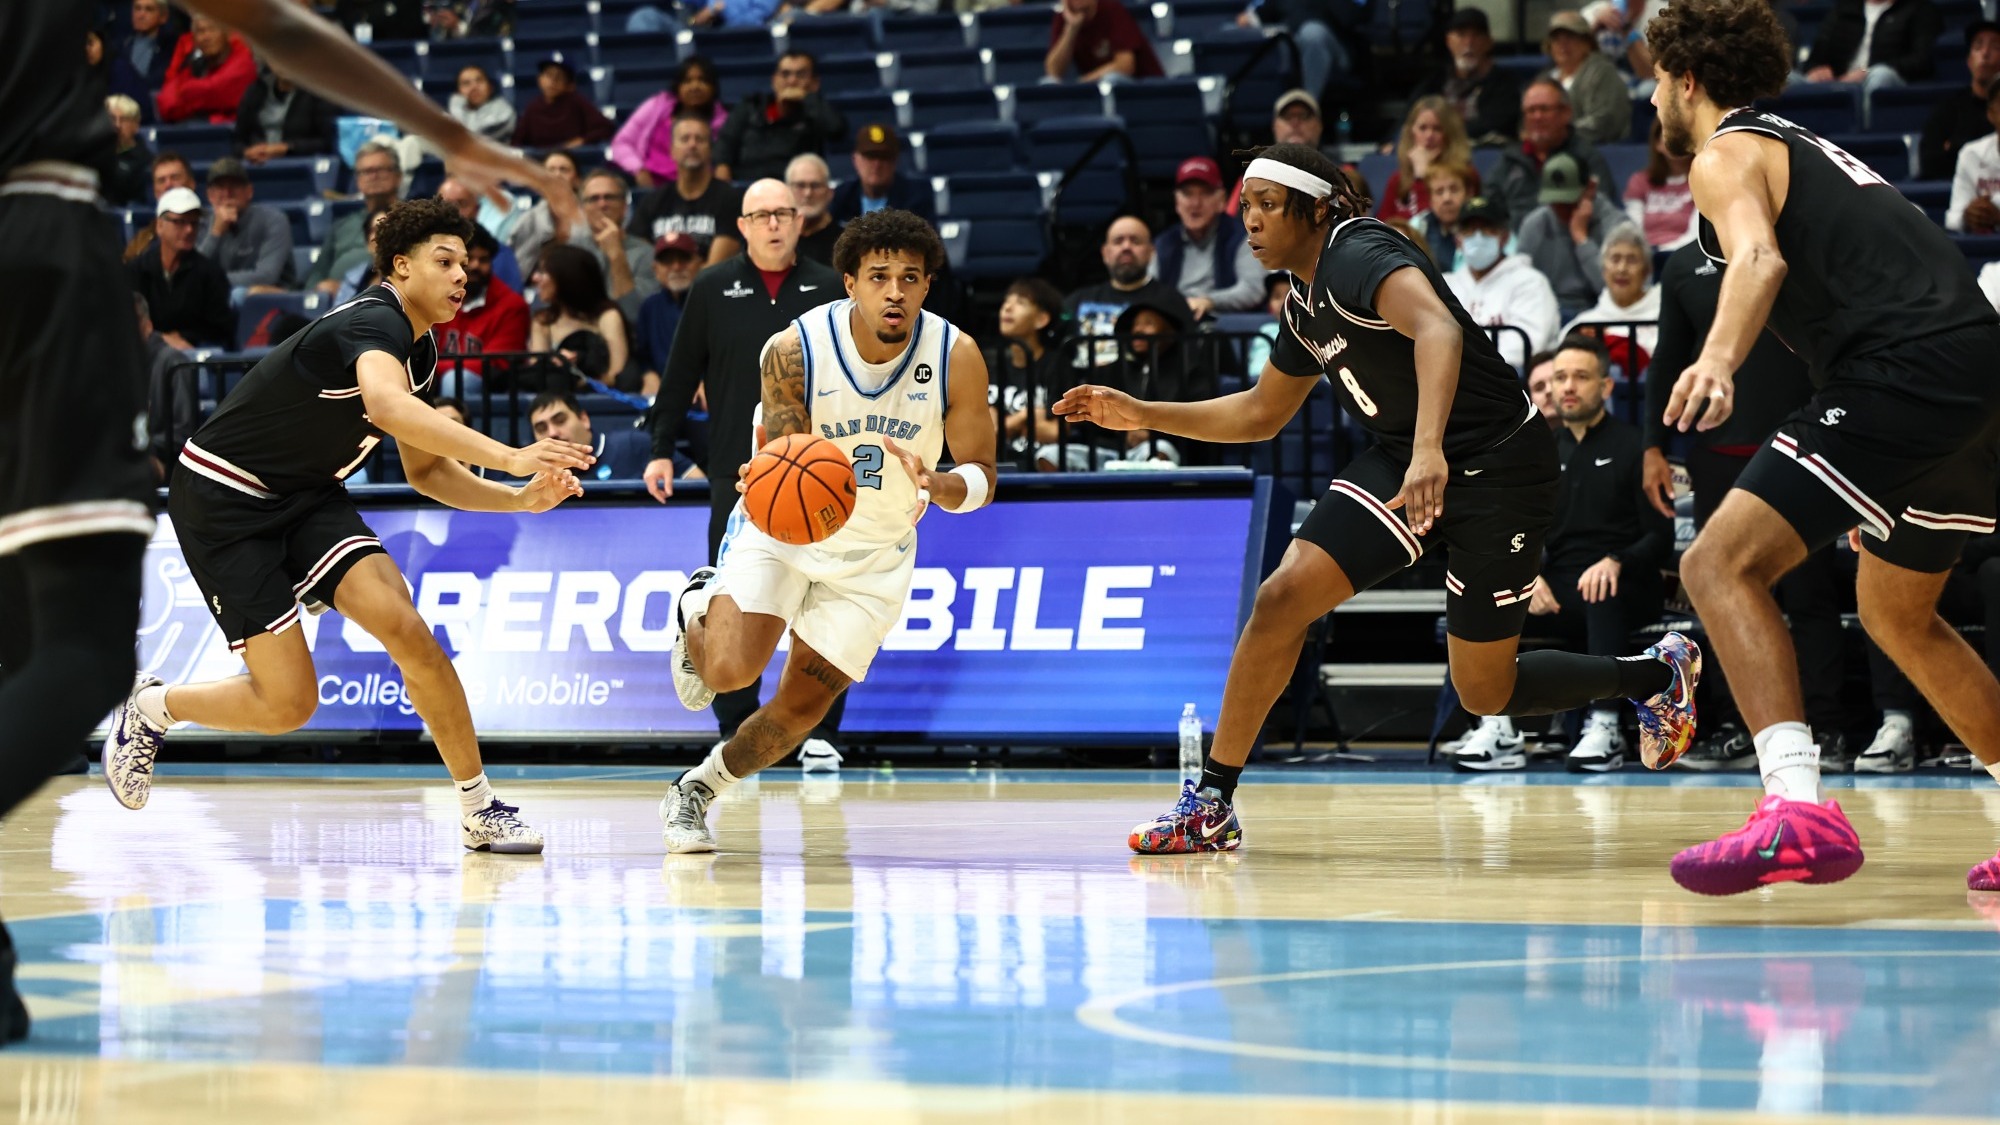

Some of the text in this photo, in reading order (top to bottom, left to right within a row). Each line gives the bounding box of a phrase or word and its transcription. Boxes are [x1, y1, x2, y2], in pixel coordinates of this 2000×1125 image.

[915, 367, 931, 380] JC
[1338, 365, 1379, 418] 8
[820, 414, 922, 440] SAN DIEGO
[852, 443, 885, 490] 2
